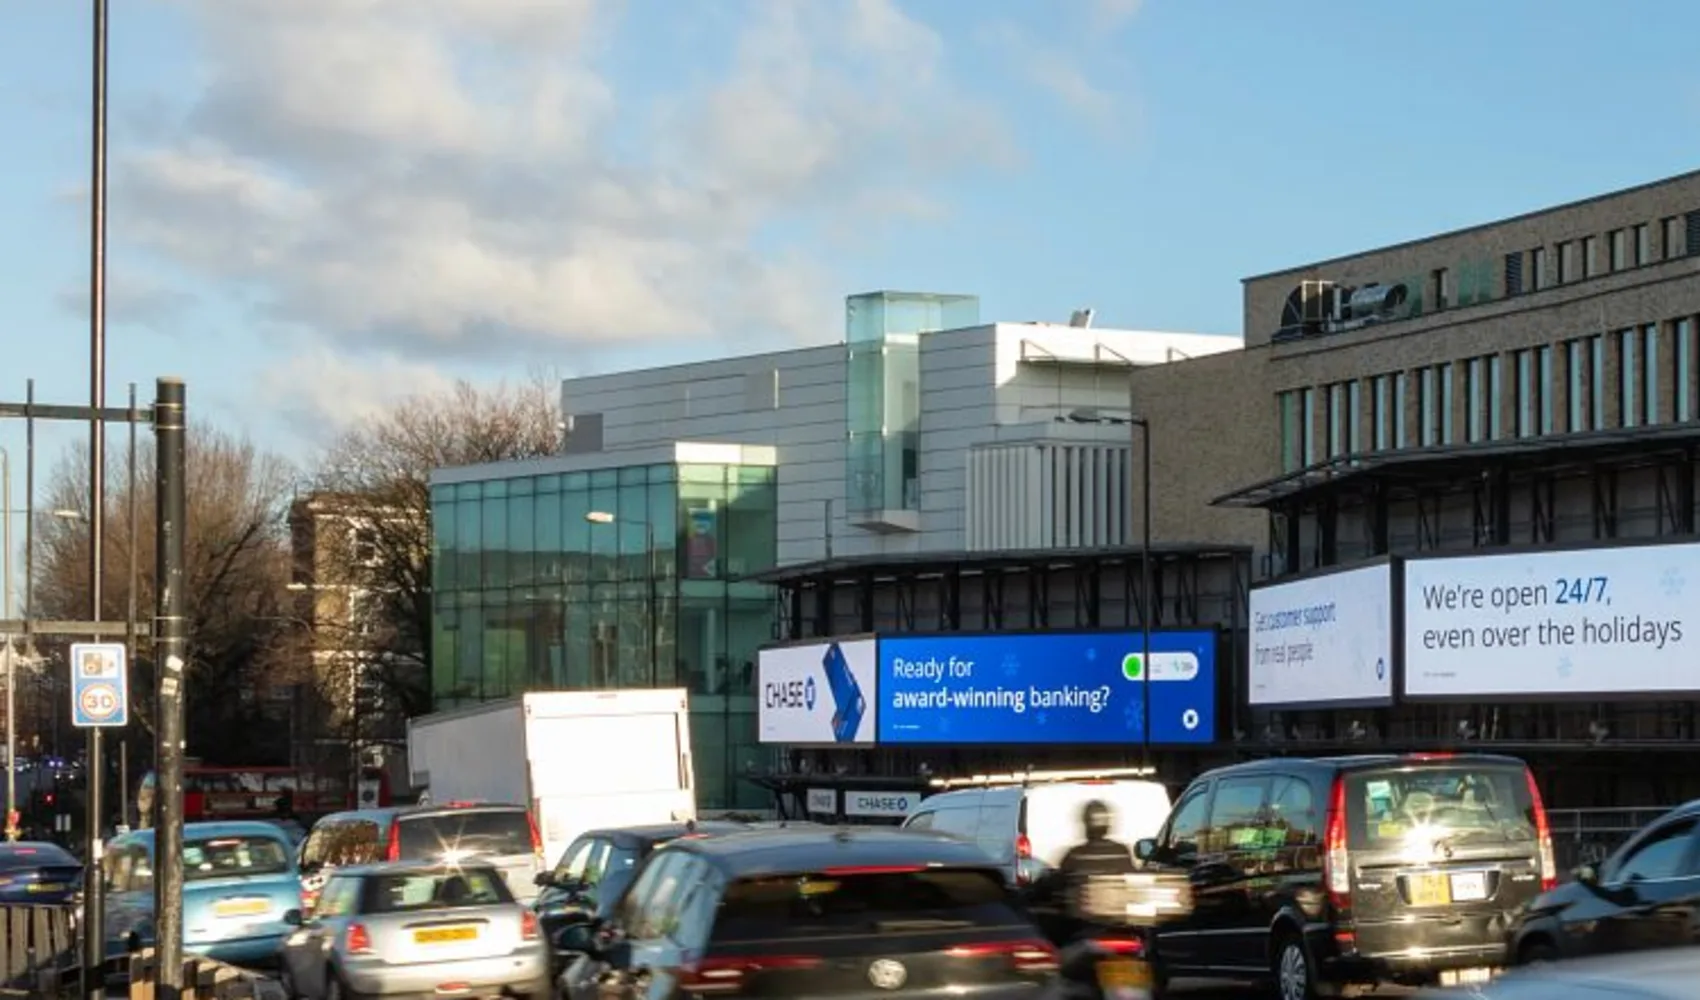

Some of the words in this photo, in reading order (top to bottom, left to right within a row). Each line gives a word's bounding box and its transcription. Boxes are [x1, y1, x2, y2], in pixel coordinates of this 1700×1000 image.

[1423, 584, 1484, 609] We're
[1490, 584, 1548, 614] open
[1555, 577, 1612, 606] 24/7,
[1423, 628, 1475, 649] even
[1482, 624, 1531, 646] over
[1538, 618, 1575, 645] the
[1583, 615, 1682, 649] holidays
[893, 657, 944, 683] Ready
[949, 656, 974, 677] for
[87, 694, 114, 709] 30
[766, 681, 803, 708] CHASE
[893, 686, 1025, 713] award-winning
[1030, 685, 1110, 712] banking?
[857, 797, 897, 810] CHASE
